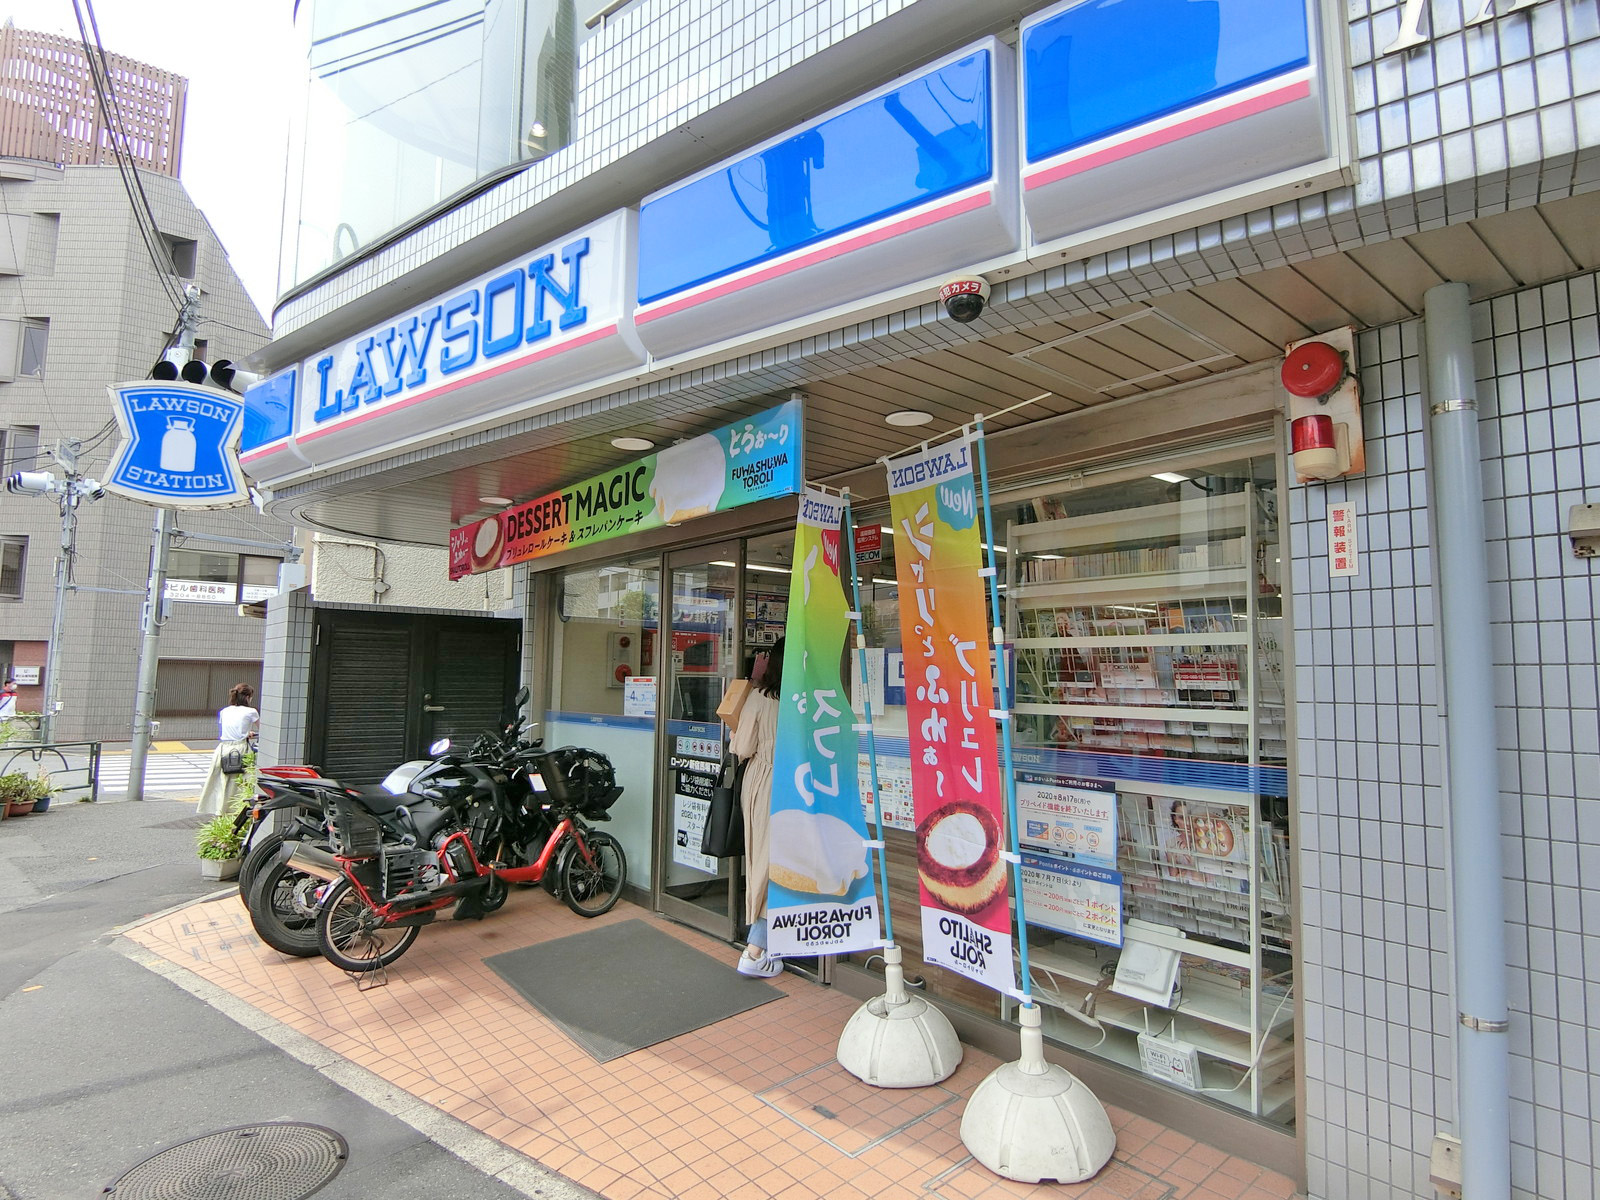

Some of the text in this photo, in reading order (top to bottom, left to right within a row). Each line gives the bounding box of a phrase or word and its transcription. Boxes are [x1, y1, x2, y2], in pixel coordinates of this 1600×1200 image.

[313, 236, 591, 423] LAWSON
[131, 397, 231, 422] LAWSON
[126, 466, 224, 489] STATION
[743, 469, 773, 489] TOROLI
[507, 466, 646, 542] DESSERT MAGIC
[1333, 509, 1347, 569] 警報装置
[856, 550, 880, 562] SECOM
[651, 607, 719, 624] ロソン銀行
